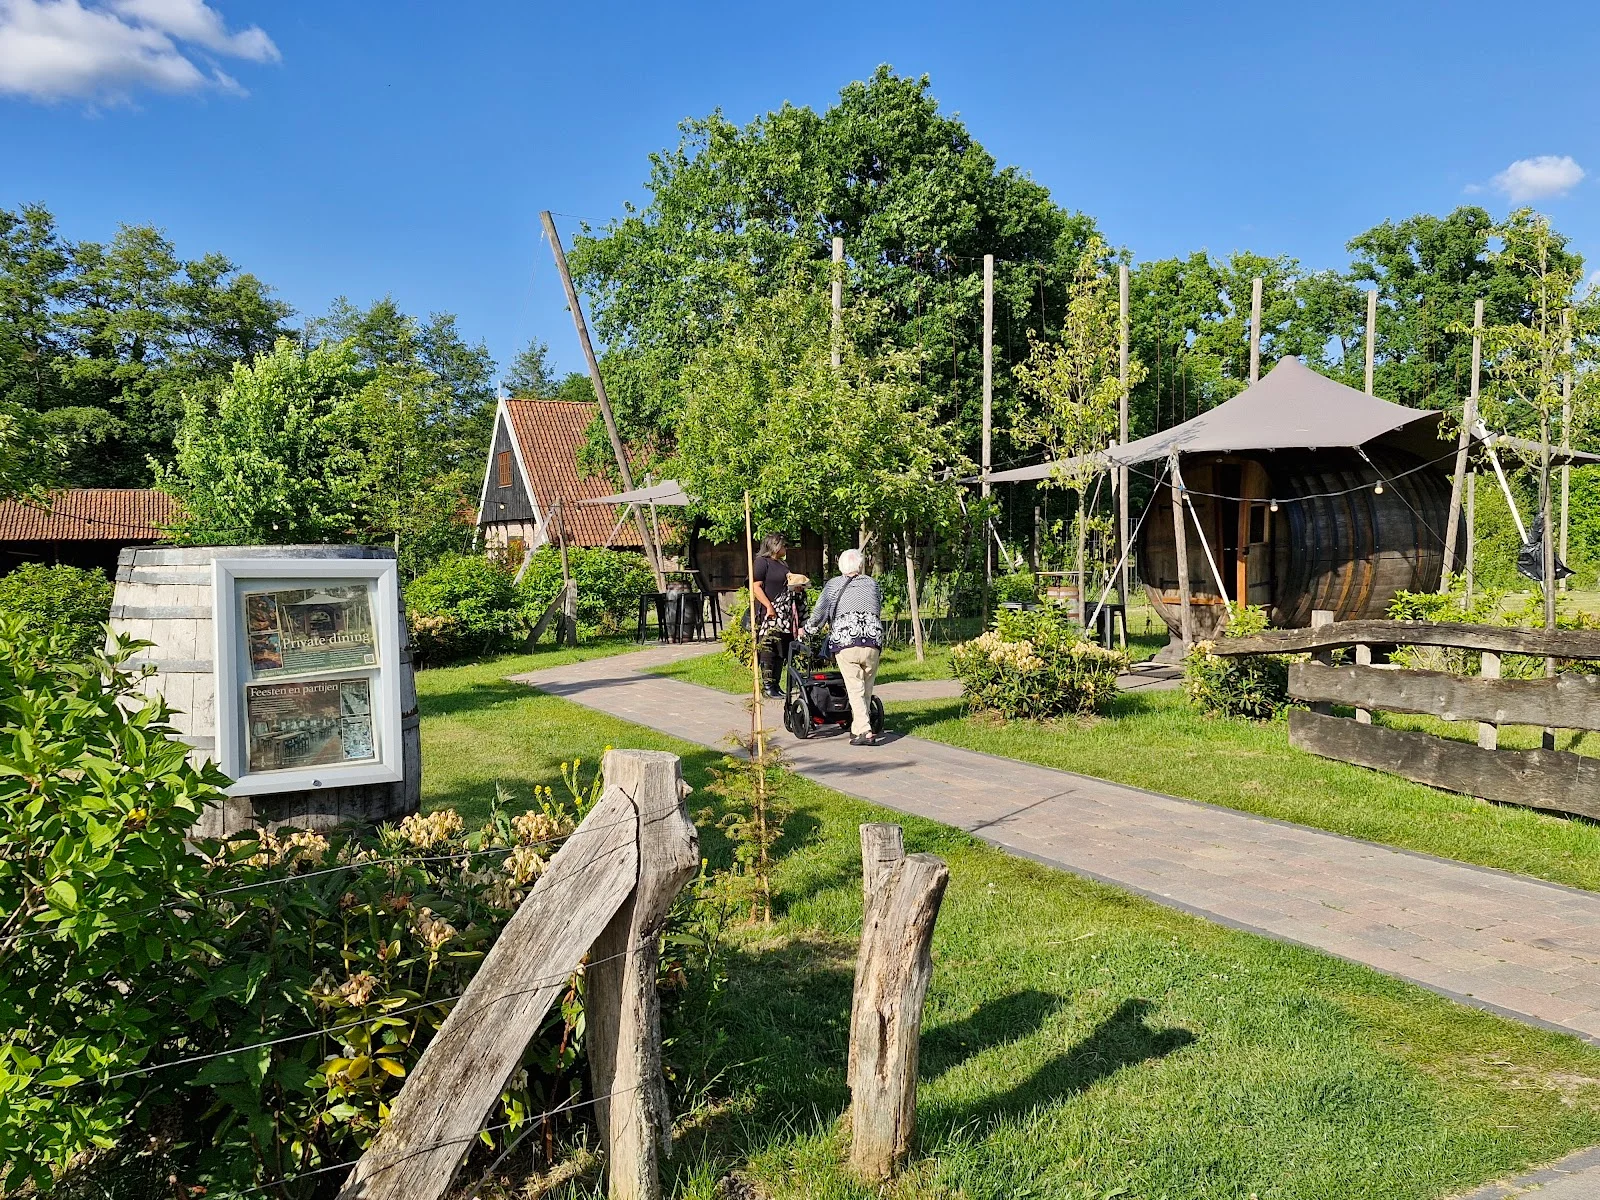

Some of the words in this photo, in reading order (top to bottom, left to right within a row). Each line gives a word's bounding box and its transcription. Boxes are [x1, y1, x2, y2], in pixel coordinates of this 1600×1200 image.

[282, 637, 326, 650] Private
[329, 632, 369, 644] dining
[250, 686, 287, 697] Feesten
[288, 686, 301, 694] en
[303, 682, 339, 695] partijen
